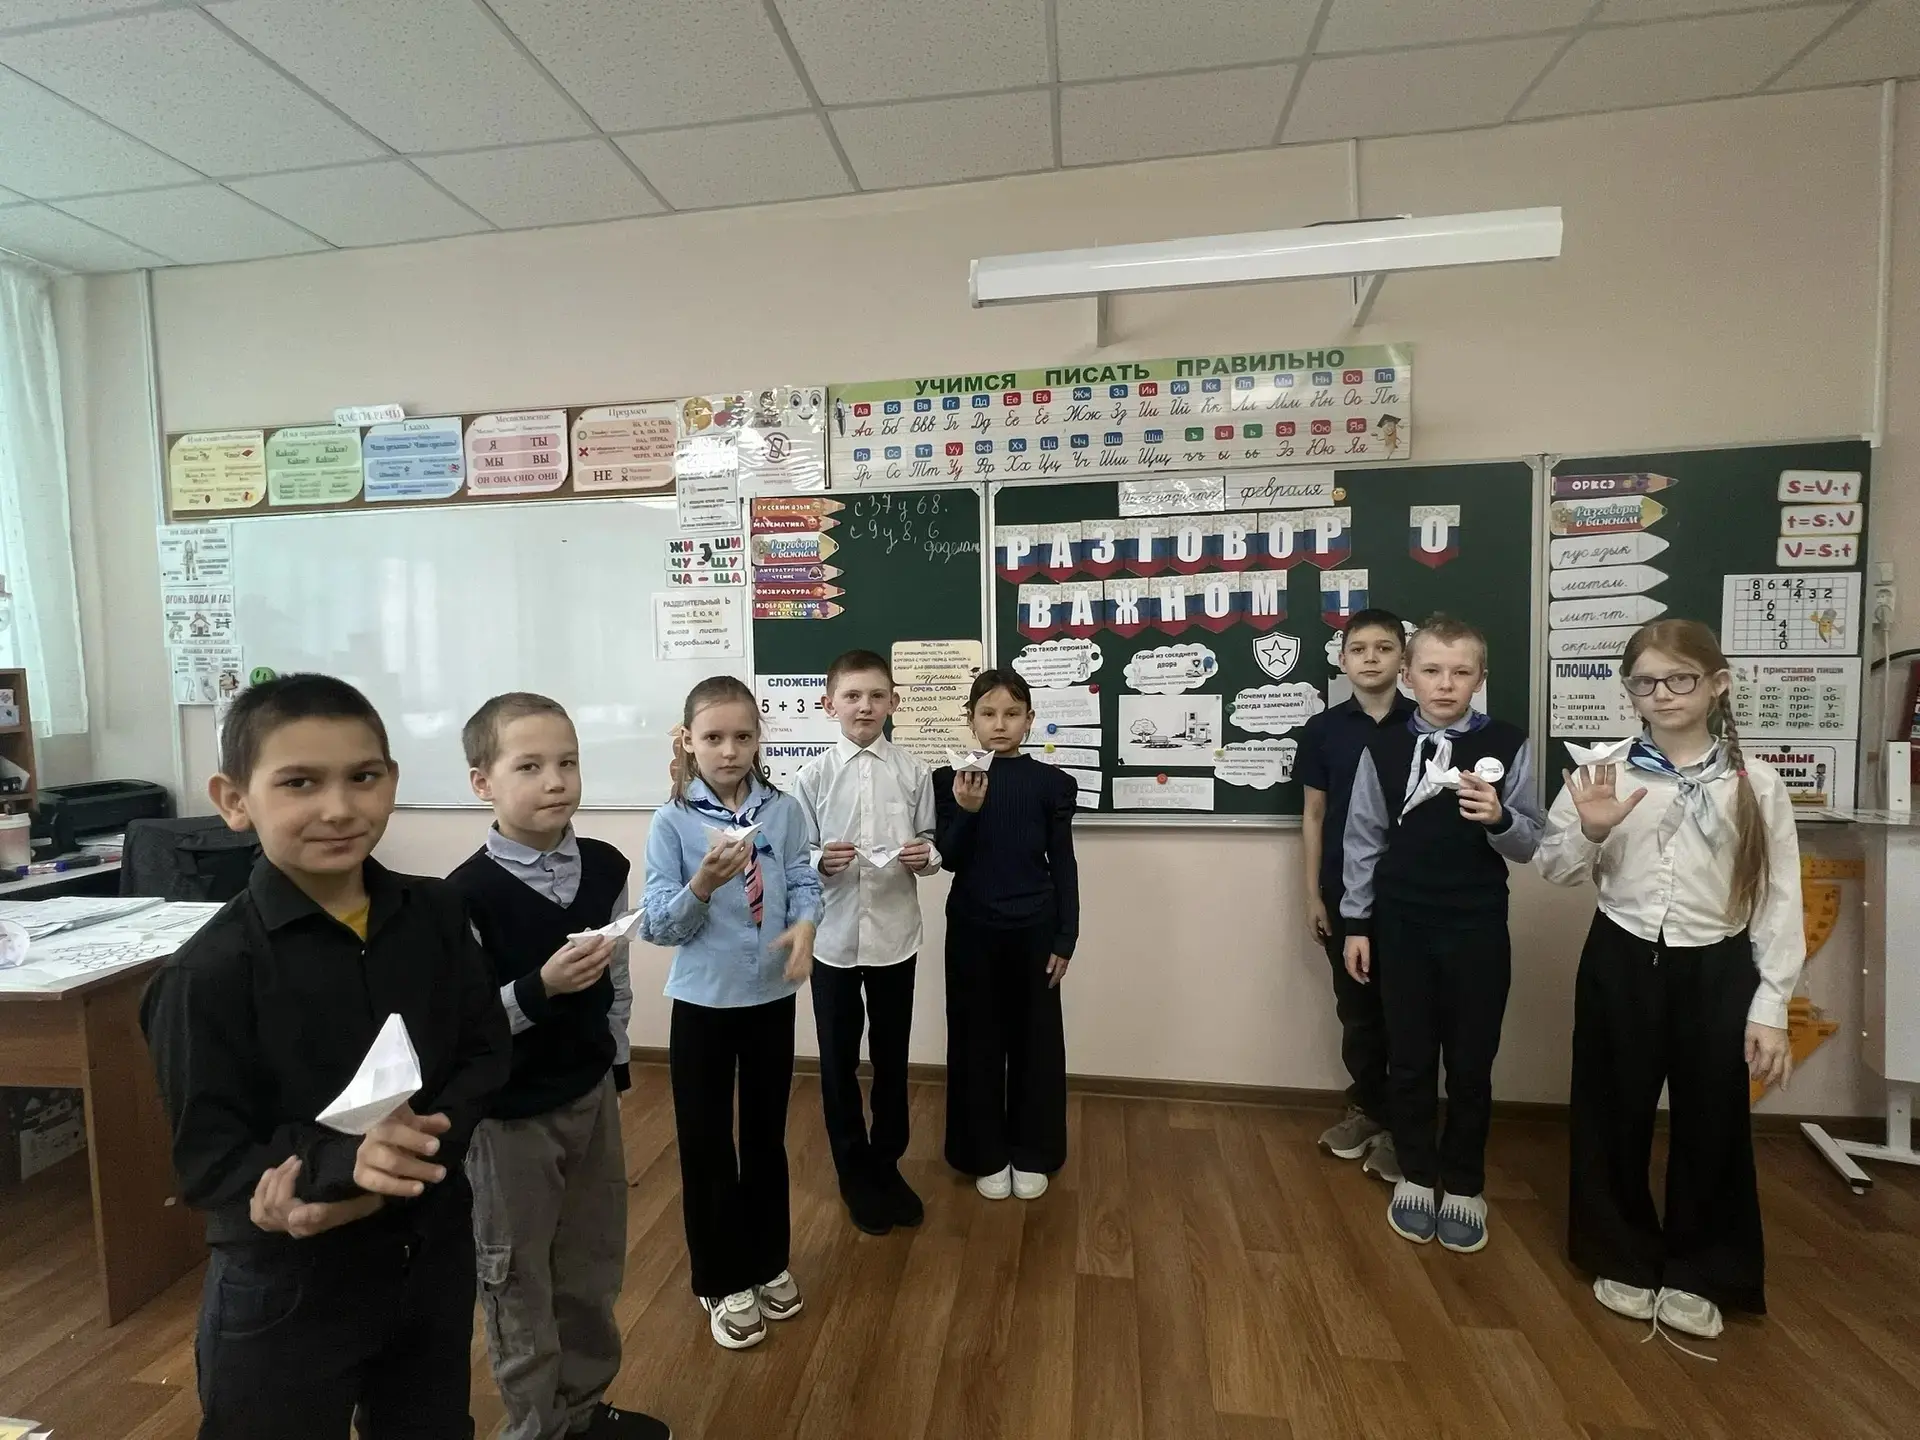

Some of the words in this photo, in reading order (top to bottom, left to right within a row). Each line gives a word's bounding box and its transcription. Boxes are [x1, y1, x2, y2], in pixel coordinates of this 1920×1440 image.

[915, 373, 1016, 396] УЧИМСЯ
[1045, 364, 1150, 386] ПИСАТЬ
[1176, 349, 1345, 377] ПРАВИЛЬНО
[852, 420, 874, 437] Аа
[881, 417, 905, 435] Бб
[943, 413, 960, 431] Гг
[971, 411, 991, 434] Дд
[1005, 409, 1020, 426] Ее
[1034, 405, 1050, 424] Ёё
[1063, 405, 1102, 422] Жж
[1110, 401, 1128, 425] Зз
[1138, 401, 1160, 418] Ии
[1170, 396, 1192, 415] Йй
[1200, 396, 1223, 413] Кк
[1232, 394, 1258, 411] Лл
[1266, 391, 1301, 410] Мм
[1309, 389, 1335, 407] Нн
[1343, 388, 1363, 406] Оо
[1370, 386, 1400, 404] Пп
[489, 440, 497, 450] Я
[530, 437, 548, 447] ТЫ
[484, 457, 504, 467] МЫ
[532, 454, 549, 464] ВЫ
[853, 463, 872, 488] Рр
[886, 462, 901, 479] Сс
[908, 459, 940, 478] Тт
[947, 459, 963, 481] Уу
[974, 457, 995, 479] Фф
[1004, 454, 1032, 472] Хх
[1038, 453, 1062, 474] Цц
[1072, 451, 1092, 468] Чч
[1099, 449, 1129, 467] Шш
[1138, 447, 1172, 468] Щщ
[1276, 440, 1294, 457] Ээ
[1305, 437, 1336, 456] Юю
[1344, 436, 1368, 454] Яя
[593, 470, 613, 481] НЕ
[1240, 476, 1323, 506] февраля
[1571, 480, 1616, 490] ОРКСЭ
[1575, 503, 1641, 519] Разговоры
[1576, 519, 1583, 527] о
[1586, 514, 1638, 526] важном
[670, 541, 693, 553] ЖИ
[715, 537, 740, 549] ШИ
[771, 538, 818, 551] Разговоры
[1006, 516, 1342, 571] РАЗГОВОР
[1420, 515, 1448, 553] О
[778, 550, 817, 558] важном
[672, 558, 691, 568] ЧУ
[711, 557, 738, 568] ЩУ
[672, 573, 692, 584] ЧА
[714, 572, 741, 583] ЩА
[1562, 579, 1628, 591] матем.
[189, 594, 209, 604] ВОДА
[663, 598, 720, 607] РАЗДЕЛИТЕЛЬНЫЙ
[1029, 579, 1279, 629] ВАЖНОМ
[1060, 643, 1093, 651] героизм?
[1555, 663, 1613, 680] ПЛОЩАДЬ
[768, 678, 826, 687] СЛОЖЕНИ
[761, 699, 770, 714] 5
[796, 698, 805, 713] 3
[766, 747, 829, 757] ВЫЧИТАН
[763, 765, 771, 779] 9
